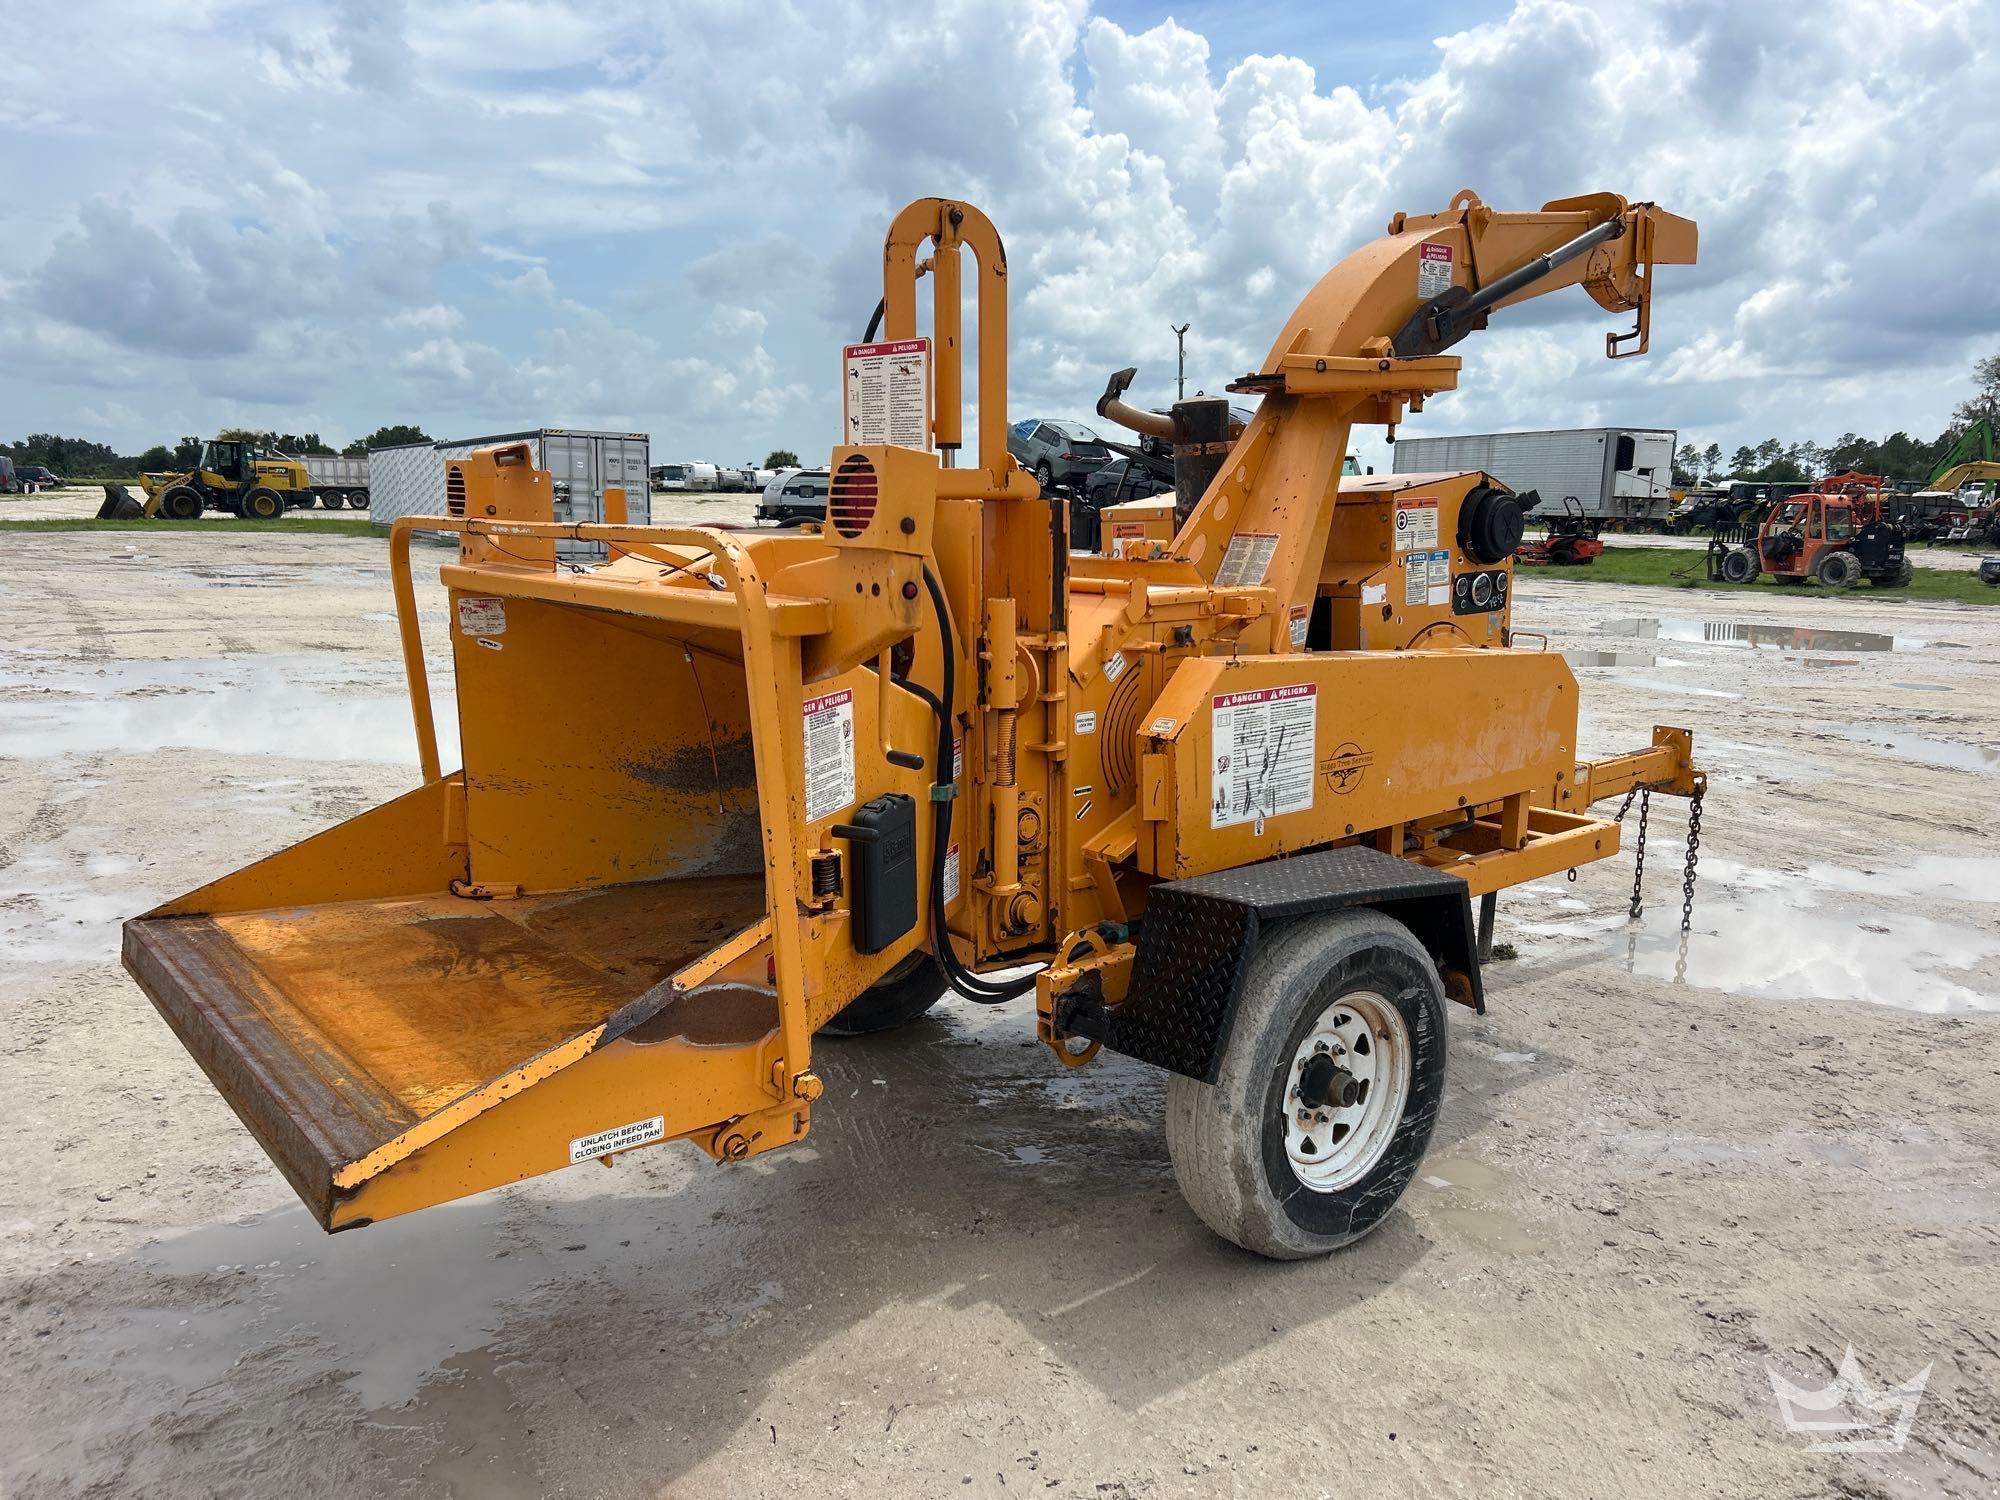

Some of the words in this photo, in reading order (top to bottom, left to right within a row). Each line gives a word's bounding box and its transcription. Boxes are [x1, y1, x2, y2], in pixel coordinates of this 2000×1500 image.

[858, 347, 876, 355] DANGER
[898, 343, 918, 351] PELIGRO
[804, 702, 816, 713] GER
[825, 693, 848, 707] PELIGRO
[1232, 692, 1262, 704] DANGER
[1279, 686, 1308, 697] PELIGRO
[1351, 755, 1373, 765] Service
[574, 1142, 611, 1159] CLOSING
[613, 1134, 642, 1148] INFEED
[644, 1128, 660, 1139] PAN
[581, 1131, 619, 1148] UNLATCH
[621, 1121, 654, 1136] BEFORE
